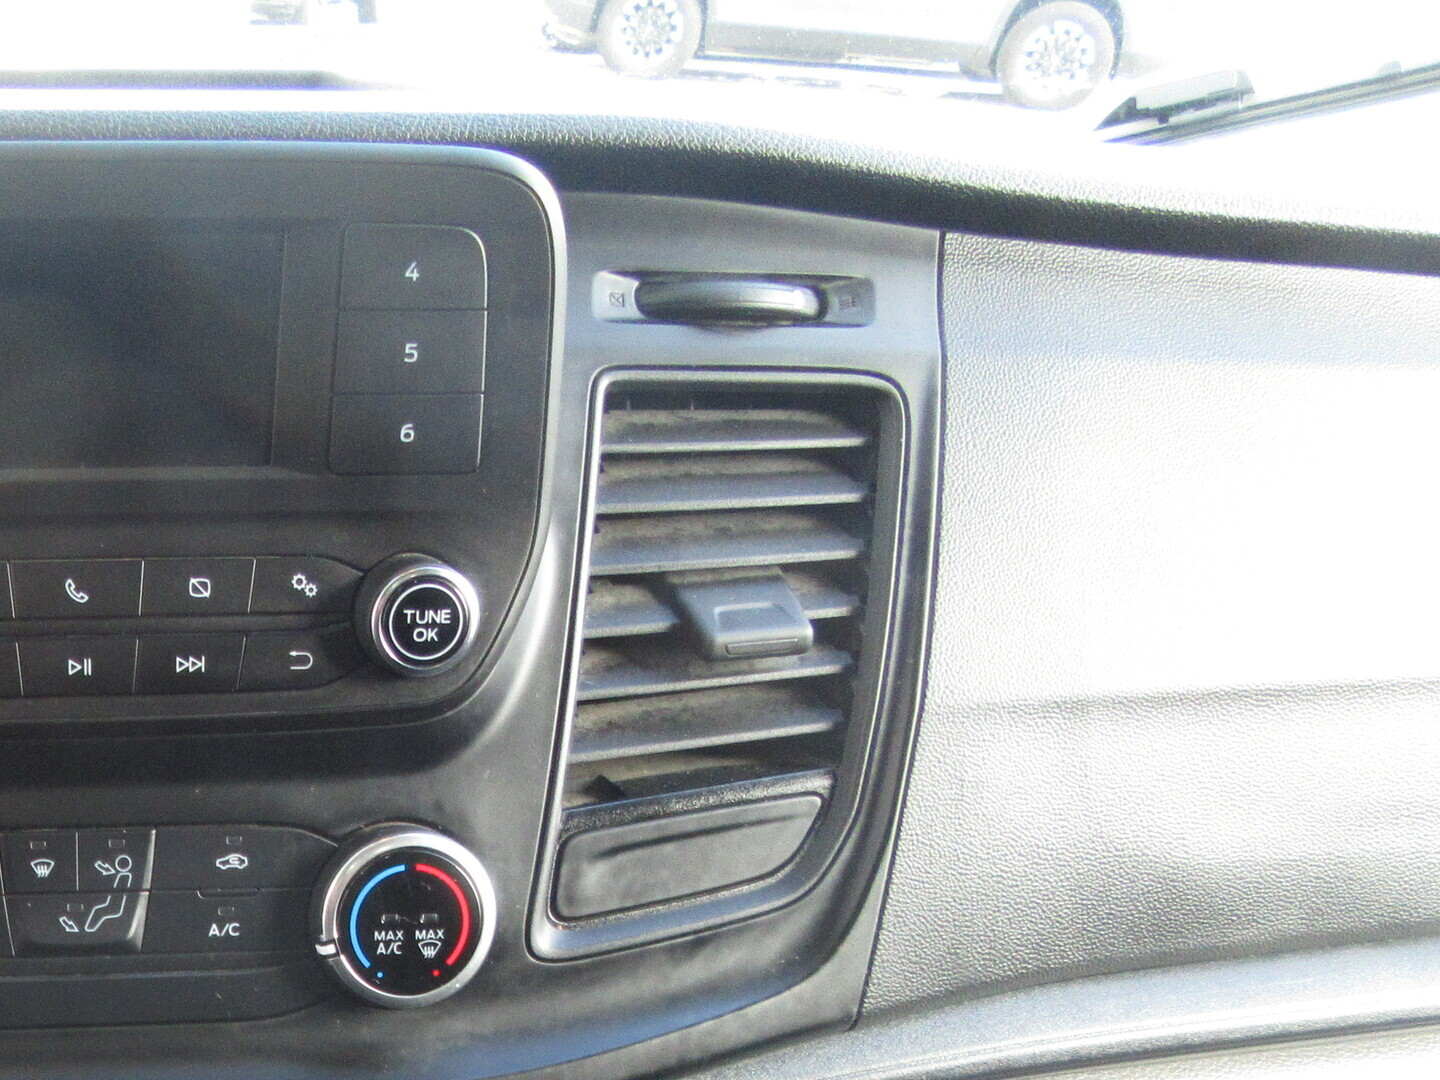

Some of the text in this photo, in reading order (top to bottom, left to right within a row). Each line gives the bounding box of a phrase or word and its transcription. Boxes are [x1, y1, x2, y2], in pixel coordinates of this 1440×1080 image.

[404, 262, 421, 282] 4
[403, 343, 419, 364] 5
[399, 422, 416, 444] 6
[402, 608, 453, 626] TUNE
[412, 626, 440, 644] OK
[207, 922, 241, 938] A/C
[373, 929, 405, 941] MAX
[414, 928, 445, 940] MAX
[376, 941, 403, 956] A/C
